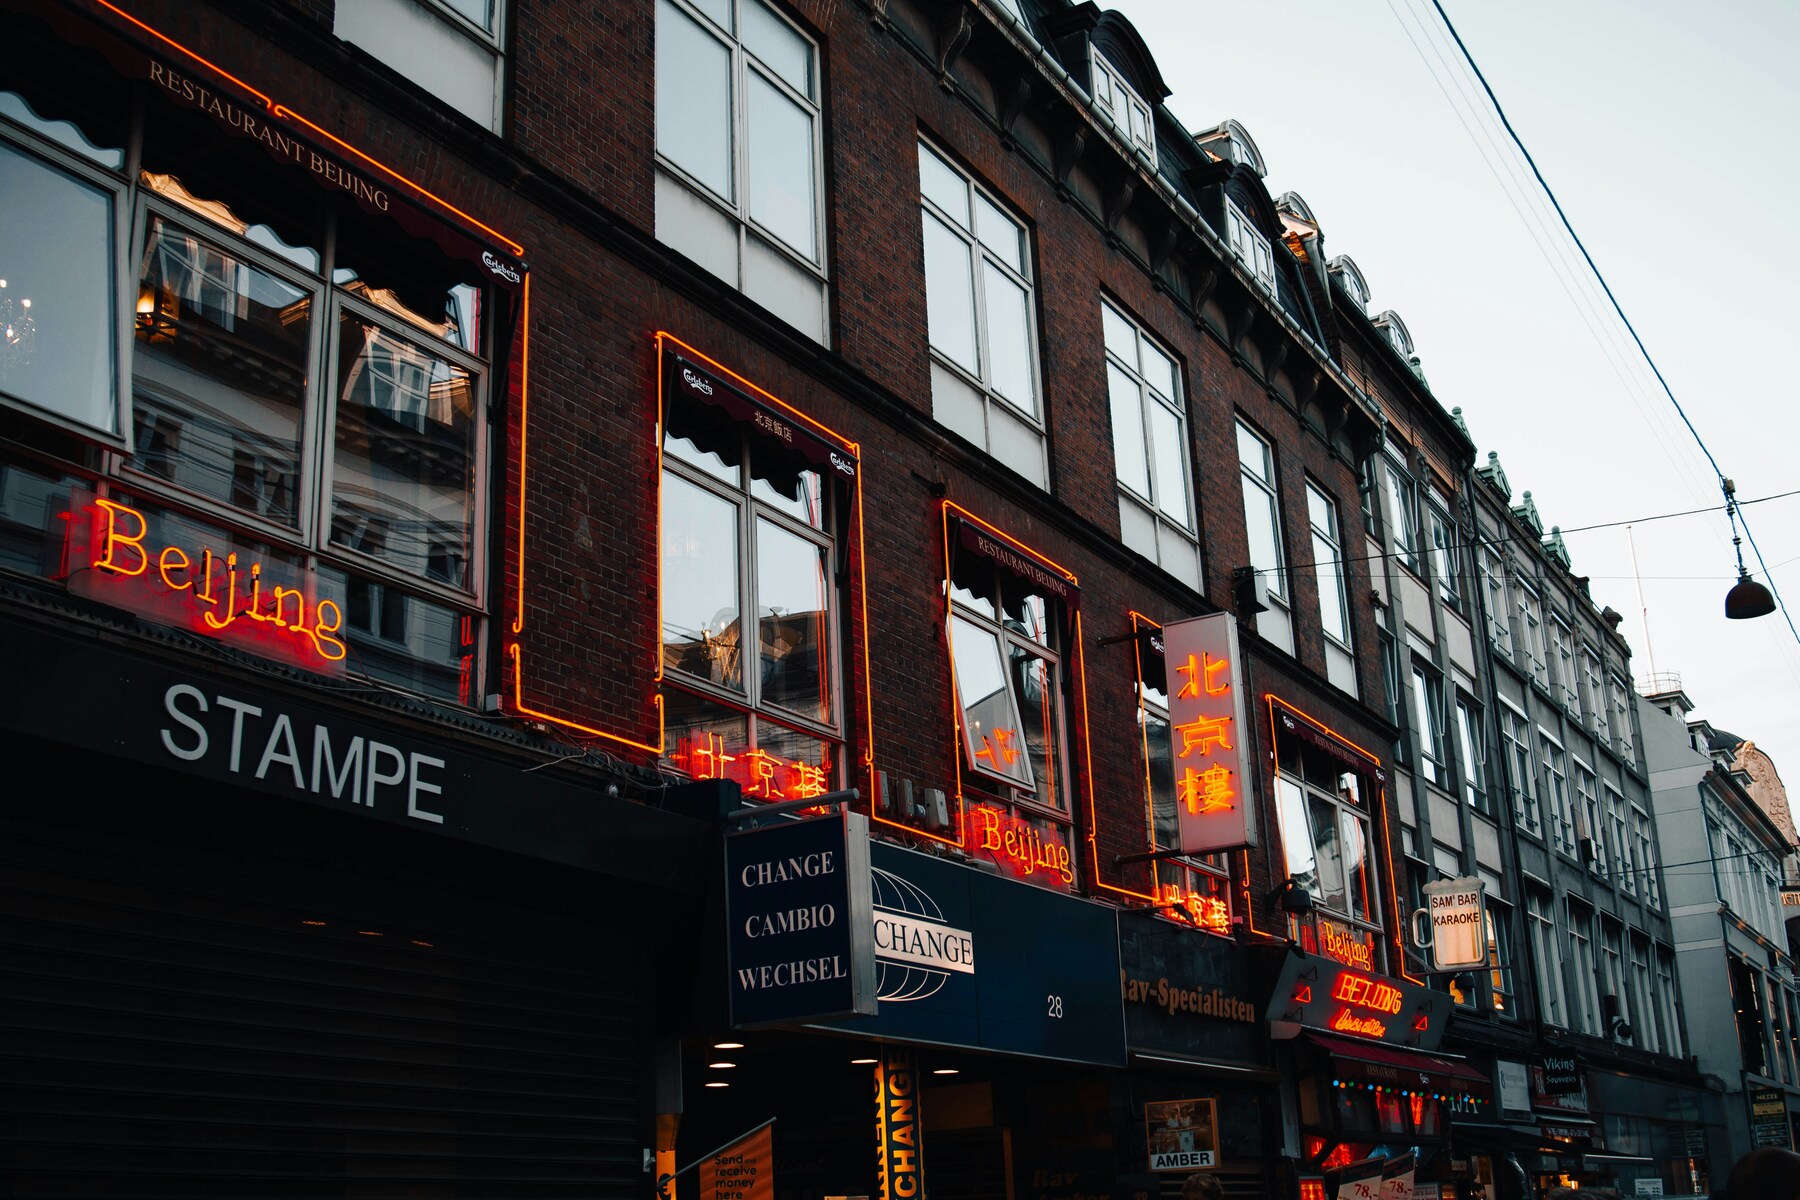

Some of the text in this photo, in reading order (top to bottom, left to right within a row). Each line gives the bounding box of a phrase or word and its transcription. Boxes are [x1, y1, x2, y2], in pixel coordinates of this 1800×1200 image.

[150, 60, 389, 212] RESTAURANT BEIJING
[482, 251, 520, 283] Carlsberg
[683, 368, 713, 396] Carlsberg
[754, 410, 793, 443] 北京飯店
[830, 452, 855, 476] Carlsberg
[93, 498, 347, 661] Beijing
[977, 536, 1067, 596] RESTAURANT BEIJING
[160, 683, 446, 825] STAMPE
[978, 807, 1073, 884] Beijing
[741, 851, 834, 888] CHANGE
[1458, 893, 1479, 906] BAR
[745, 904, 835, 938] CAMBIO
[1433, 912, 1480, 926] KARAOKE
[873, 919, 974, 966] CHANGE
[1322, 922, 1371, 972] Beijing
[738, 955, 847, 991] WECHSEL
[1047, 994, 1063, 1018] 28
[1336, 975, 1402, 1014] BEIJING
[1543, 1057, 1575, 1071] Viking
[714, 1154, 743, 1165] Send
[715, 1165, 757, 1177] receive
[1156, 1152, 1210, 1168] AMBER
[715, 1178, 755, 1189] money
[716, 1190, 743, 1200] here
